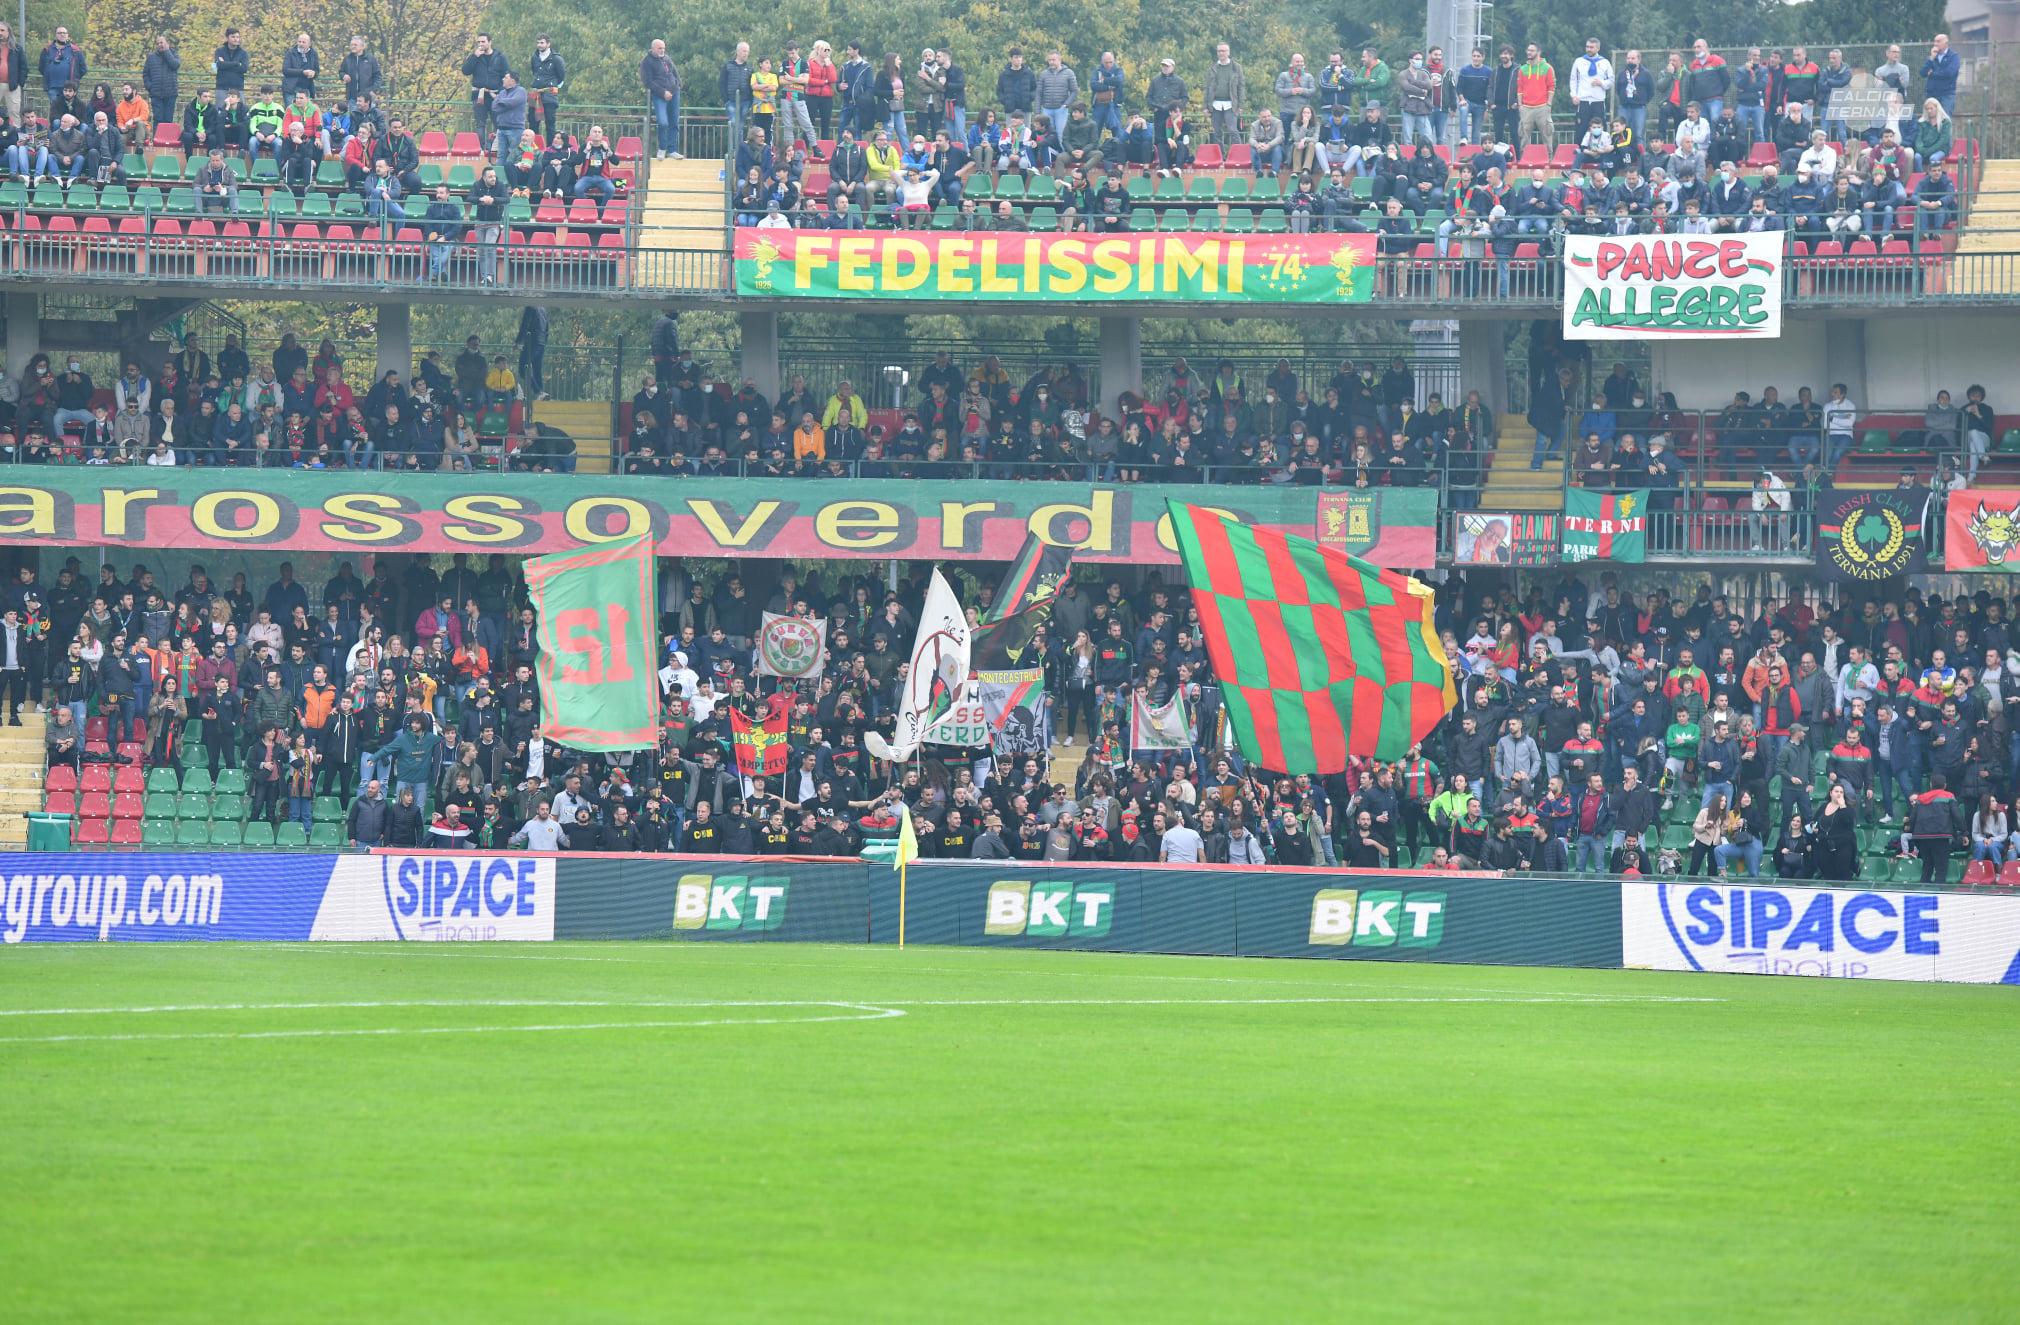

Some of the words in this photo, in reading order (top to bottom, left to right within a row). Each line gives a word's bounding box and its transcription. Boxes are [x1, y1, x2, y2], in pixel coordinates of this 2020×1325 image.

[794, 236, 1246, 293] FEDELISSIMI
[1268, 253, 1303, 281] 74
[1596, 239, 1749, 282] PANZE
[1336, 286, 1354, 297] 1925
[1571, 284, 1769, 327] ALLEGRE
[1833, 493, 1872, 519] IRISH
[1876, 493, 1913, 517] CLAN
[1512, 514, 1557, 541] GIANNI
[1565, 516, 1641, 534] TERNI
[1563, 543, 1599, 556] PARK
[1829, 544, 1893, 580] TERNANA
[1892, 544, 1916, 571] 1991
[397, 858, 536, 917] SIPACE
[677, 884, 784, 921] BKT
[0, 874, 223, 943] group.com
[987, 891, 1111, 927] BKT
[1312, 900, 1442, 938] BKT
[1686, 886, 1940, 955] SIPACE
